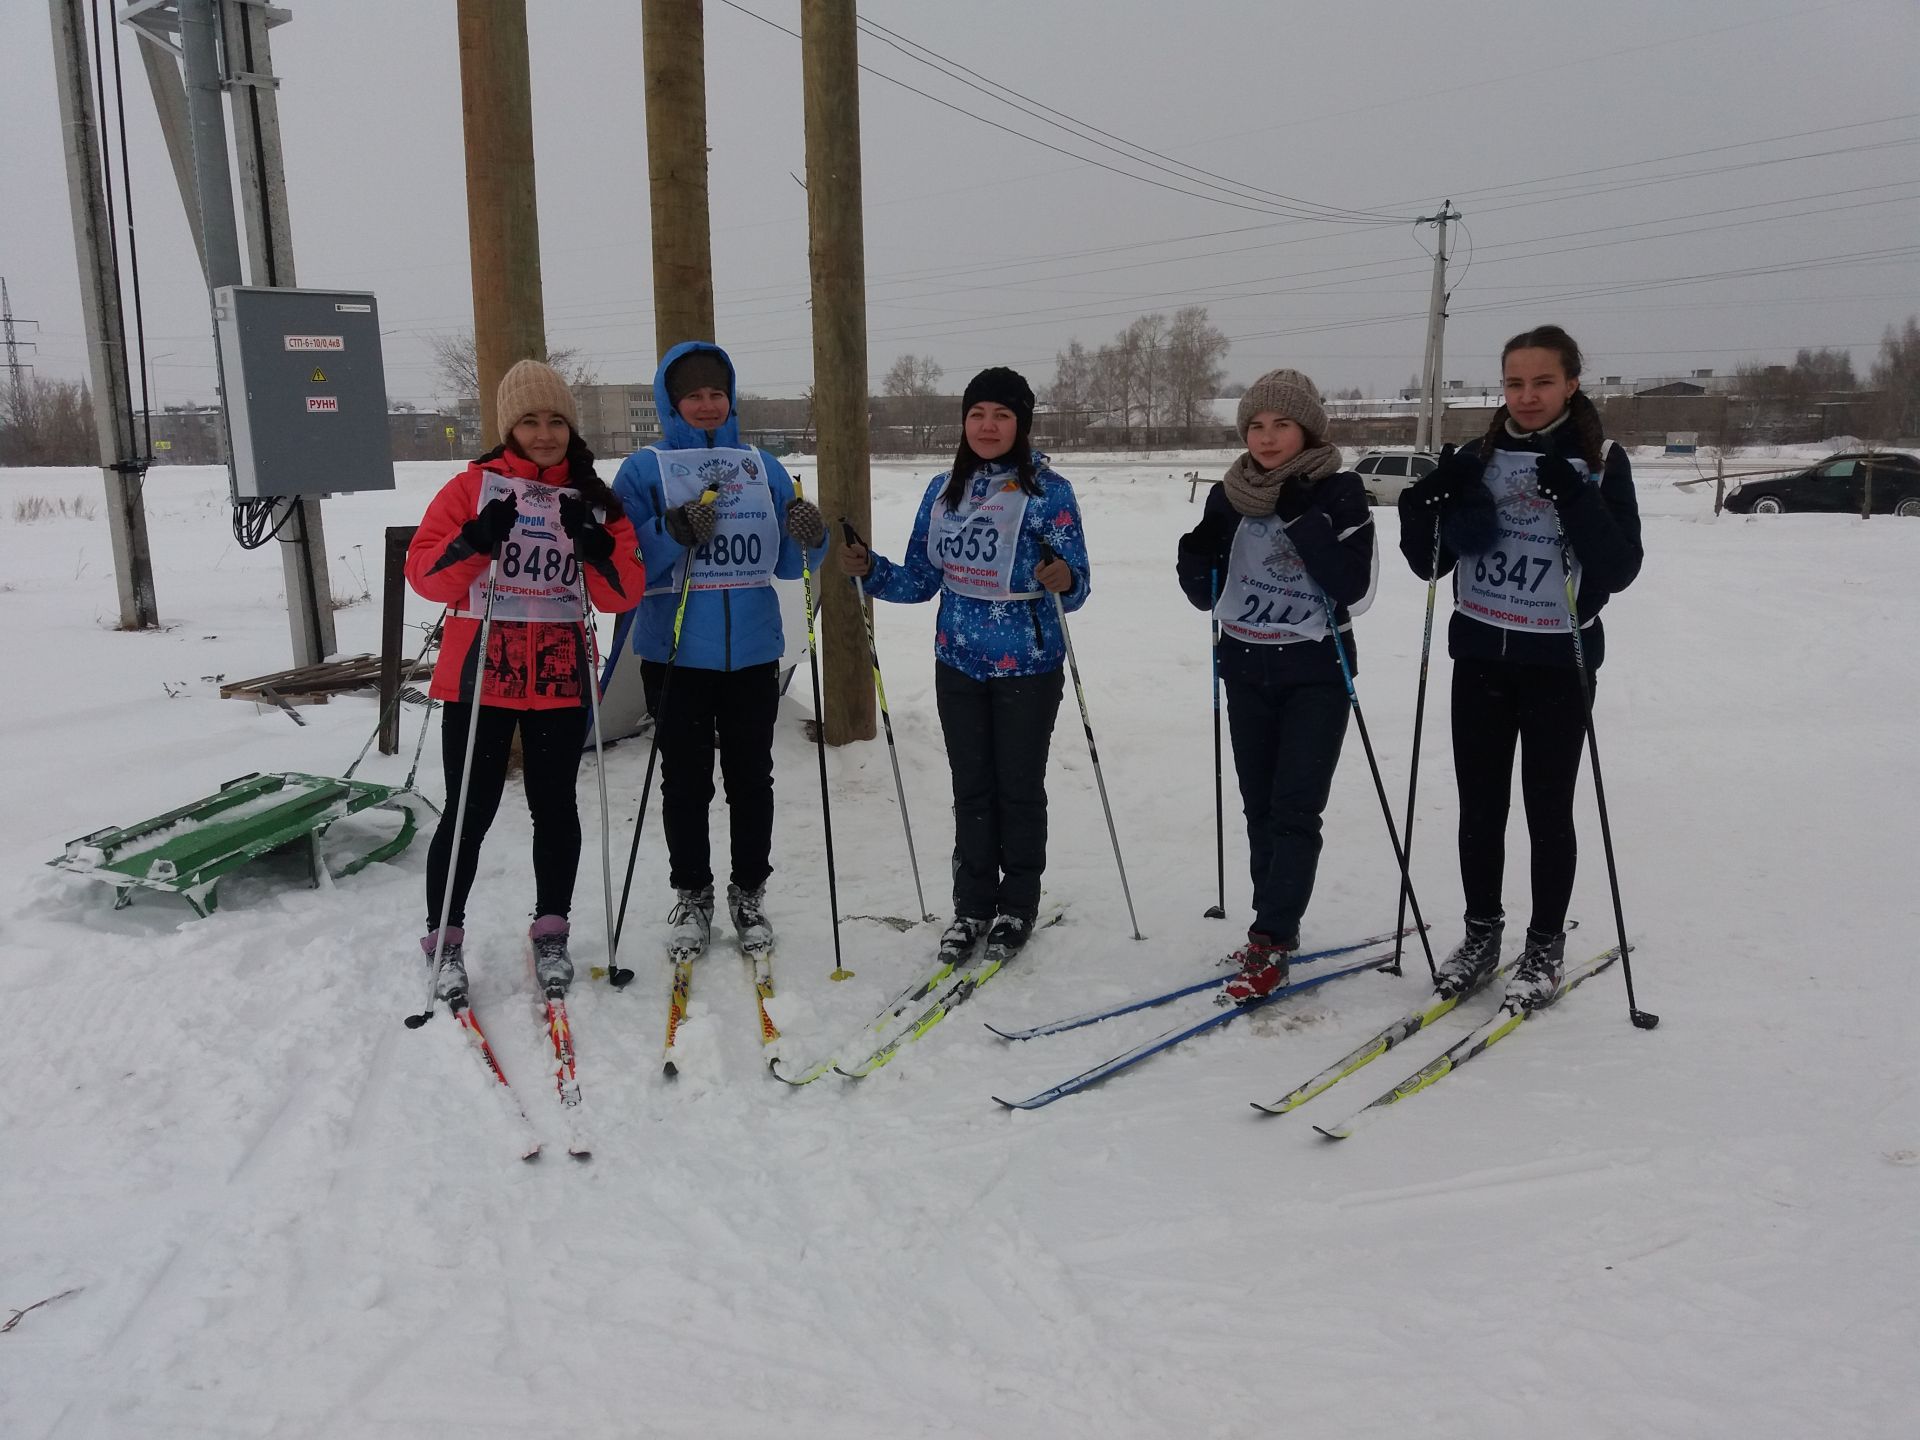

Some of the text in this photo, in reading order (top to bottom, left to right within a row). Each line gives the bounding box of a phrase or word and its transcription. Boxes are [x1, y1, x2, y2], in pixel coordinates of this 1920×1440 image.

[309, 399, 336, 409] РУНН
[698, 458, 734, 474] ЛЫЖНЯ
[1511, 466, 1537, 477] ЛЫЖ
[1500, 510, 1540, 525] РОССИИ
[695, 533, 762, 566] 4800
[503, 542, 578, 586] 8480
[1475, 550, 1553, 593] 6347
[690, 570, 733, 578] еспублика
[966, 567, 998, 577] РОССИИ
[1267, 567, 1304, 583] РОССИИ
[480, 582, 552, 595] НБЕРЕЖНЫЕ
[970, 579, 1000, 588] ЧЕЛНЫ
[1472, 584, 1557, 607] Республика Татарстан
[1490, 609, 1528, 624] РОССИИ
[1537, 618, 1560, 626] 2017
[1248, 629, 1281, 639] РОССИИ
